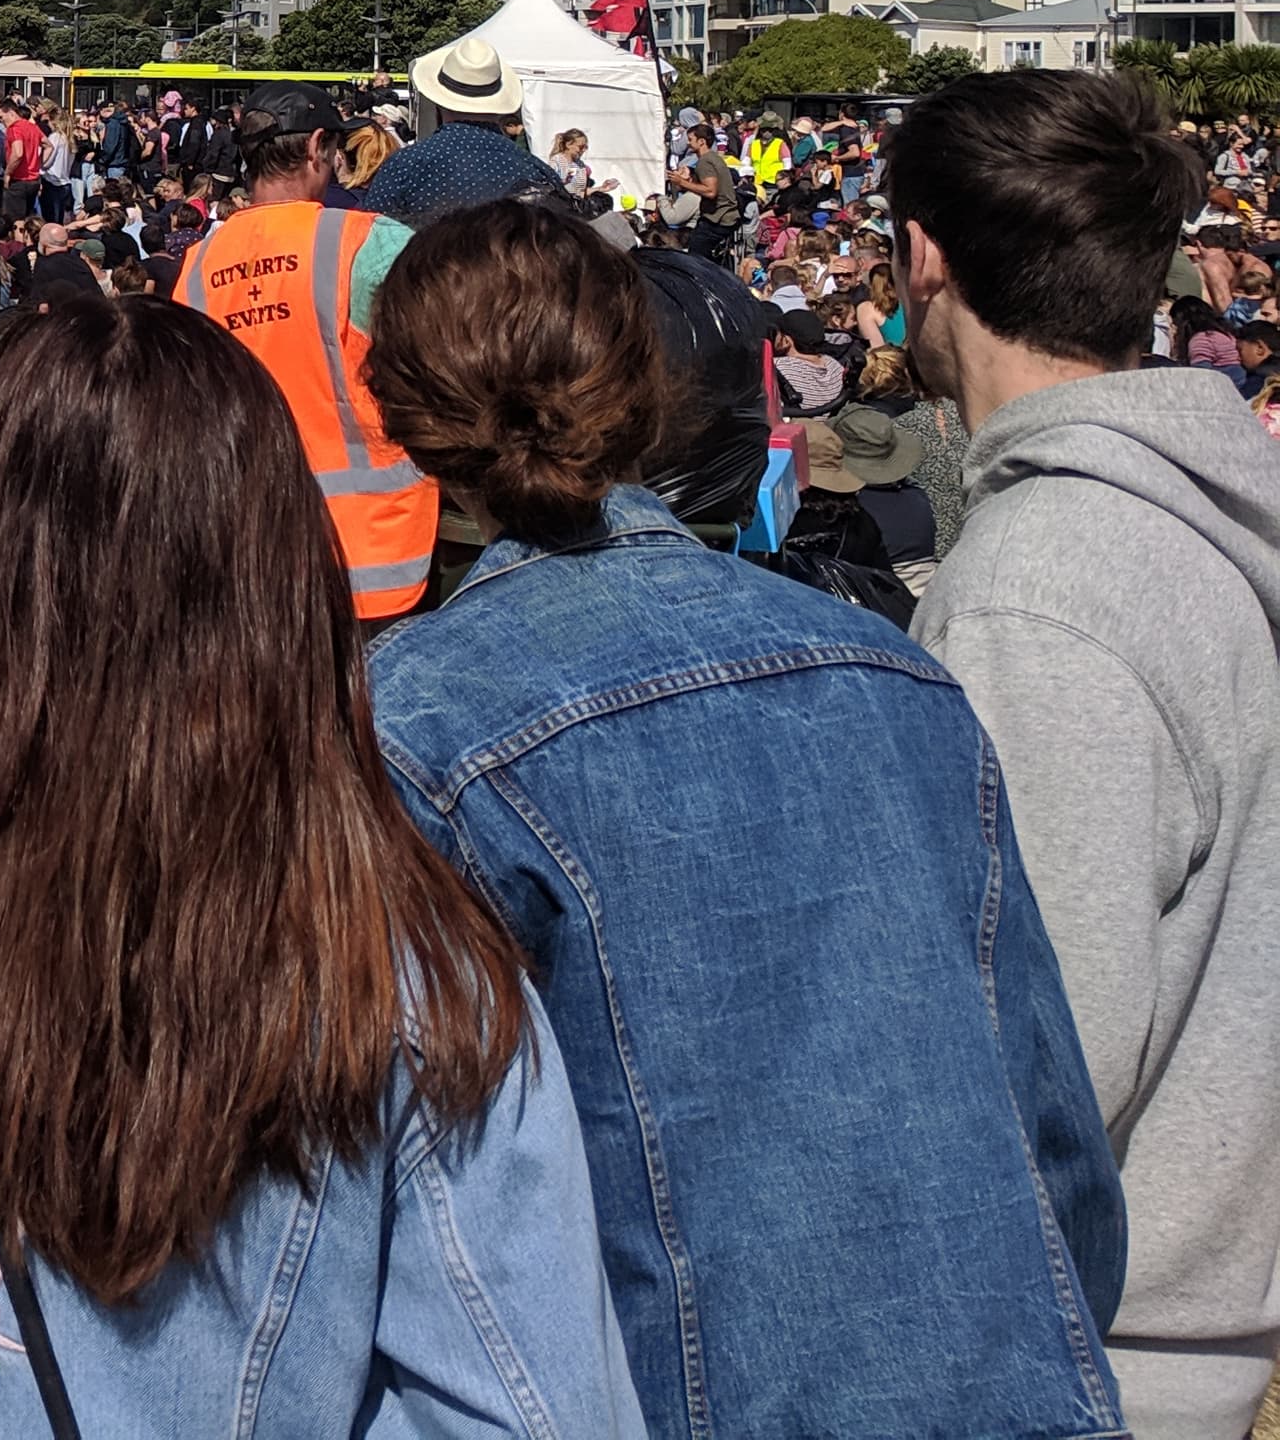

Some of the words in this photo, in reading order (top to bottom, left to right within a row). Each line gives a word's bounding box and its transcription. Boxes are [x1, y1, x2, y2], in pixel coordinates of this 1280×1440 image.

[210, 262, 248, 289] CITY
[252, 254, 299, 278] ARTS
[247, 284, 262, 302] +
[223, 302, 291, 331] EVTS
